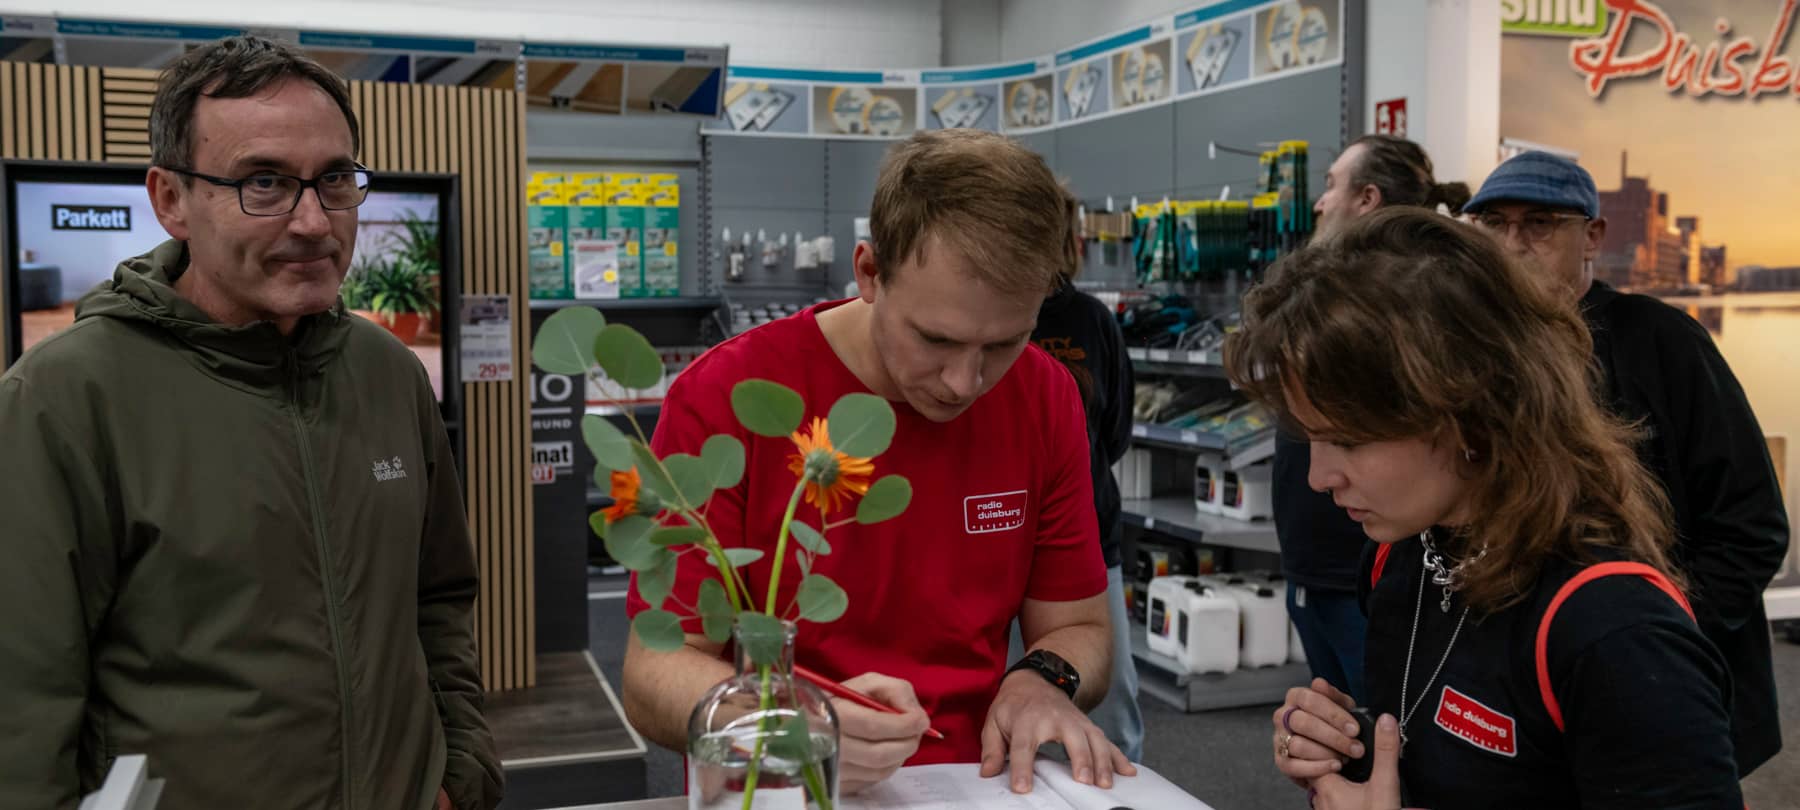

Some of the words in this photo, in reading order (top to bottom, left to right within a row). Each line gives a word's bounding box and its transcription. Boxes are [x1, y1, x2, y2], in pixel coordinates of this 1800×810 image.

[1571, 0, 1800, 97] Duisb
[55, 207, 128, 228] Parkett
[371, 459, 391, 472] Jack
[372, 468, 407, 482] Wolfskin
[977, 501, 1003, 511] radio
[977, 508, 1021, 520] duisburg
